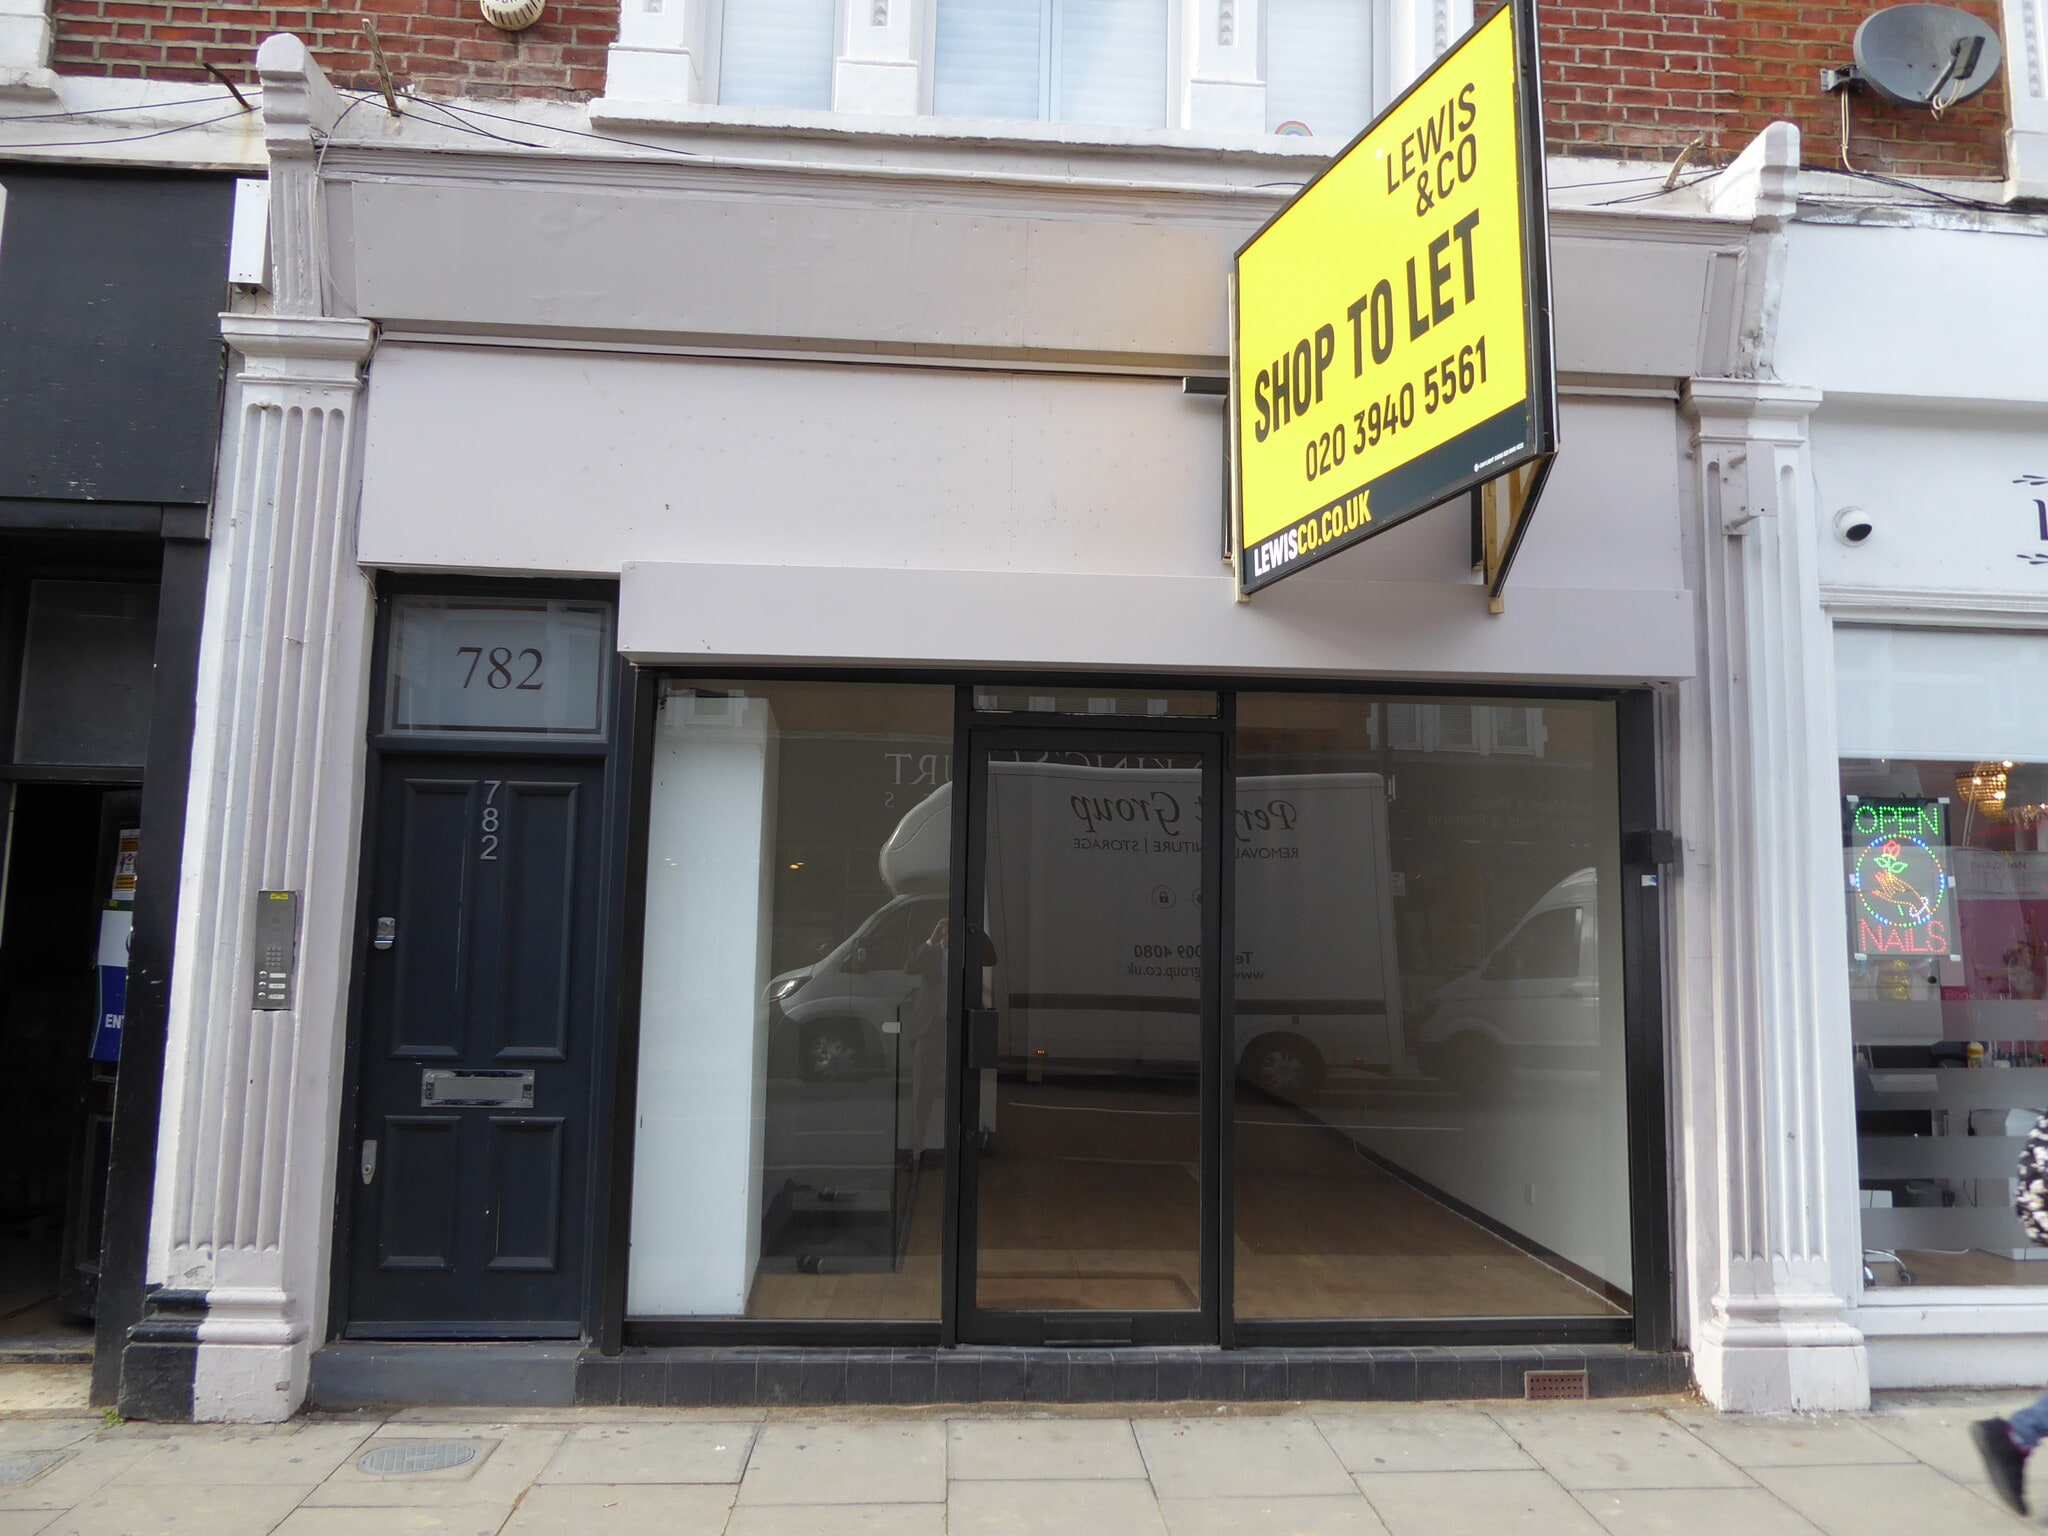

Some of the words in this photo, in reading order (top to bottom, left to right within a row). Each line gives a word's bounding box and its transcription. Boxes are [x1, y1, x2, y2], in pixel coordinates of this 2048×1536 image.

[1387, 83, 1476, 195] LEWIS
[1416, 133, 1477, 217] &CO
[1254, 323, 1335, 443] SHOP
[1347, 279, 1394, 380] TO
[1406, 208, 1480, 342] LET
[1305, 423, 1346, 482] 020
[1353, 382, 1415, 456] 3940
[1424, 335, 1487, 415] 5561
[1254, 490, 1372, 577] LEWISCO.CO.UK
[456, 647, 544, 690] 782
[480, 780, 502, 860] 782
[1855, 805, 1939, 835] OPEN
[1859, 919, 1947, 954] NAILS
